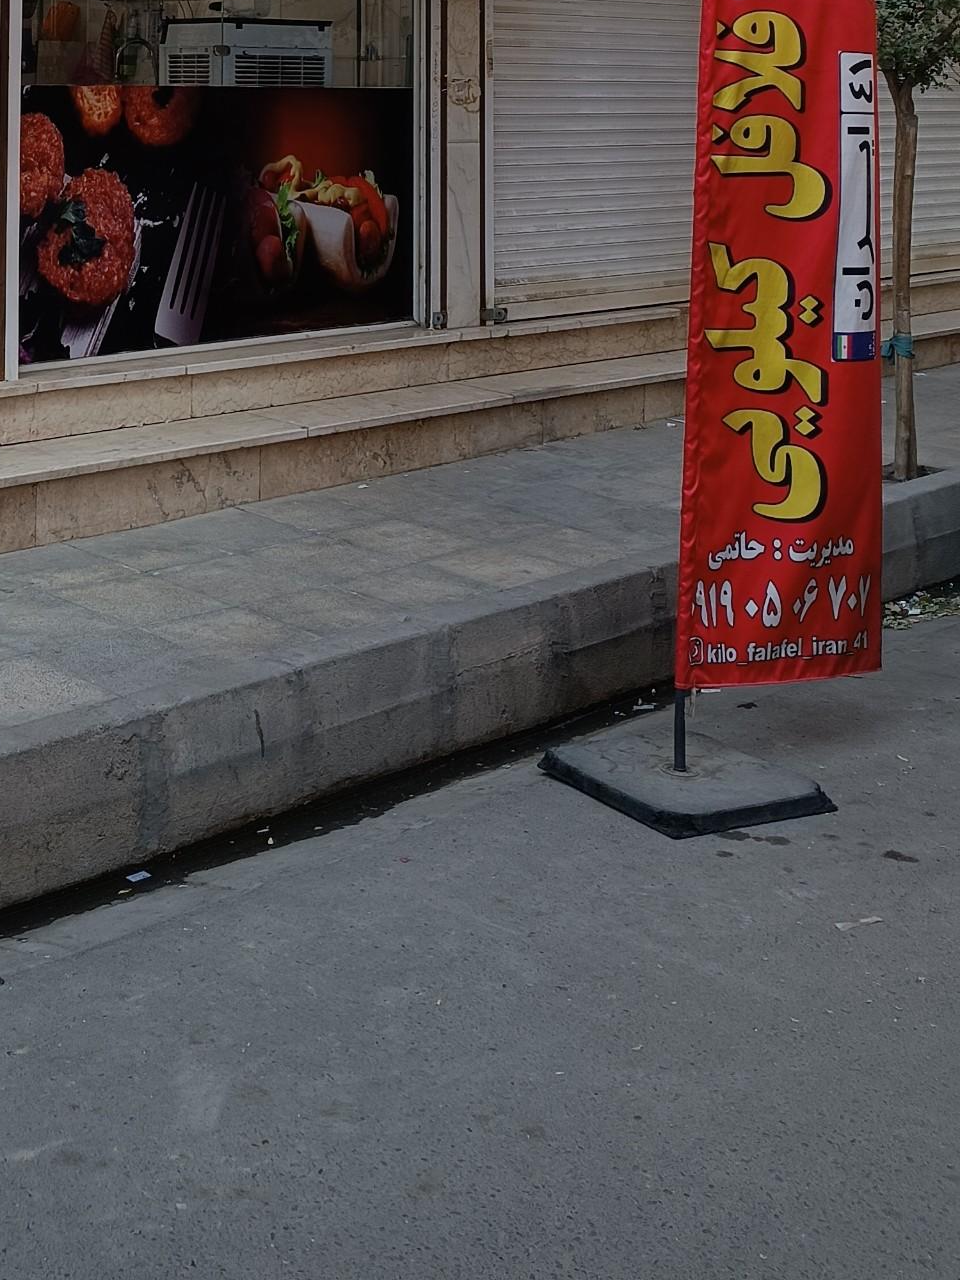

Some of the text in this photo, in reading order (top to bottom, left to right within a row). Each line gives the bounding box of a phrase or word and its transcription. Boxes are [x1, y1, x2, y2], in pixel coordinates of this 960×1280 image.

[703, 9, 833, 523] فلافل کیلویی
[707, 531, 766, 571] حاتمی
[787, 535, 855, 569] مدیریت
[691, 579, 735, 628] ۹۱۹
[744, 579, 783, 629] ۰۵
[706, 630, 868, 666] kilo_falafel_iran_41
